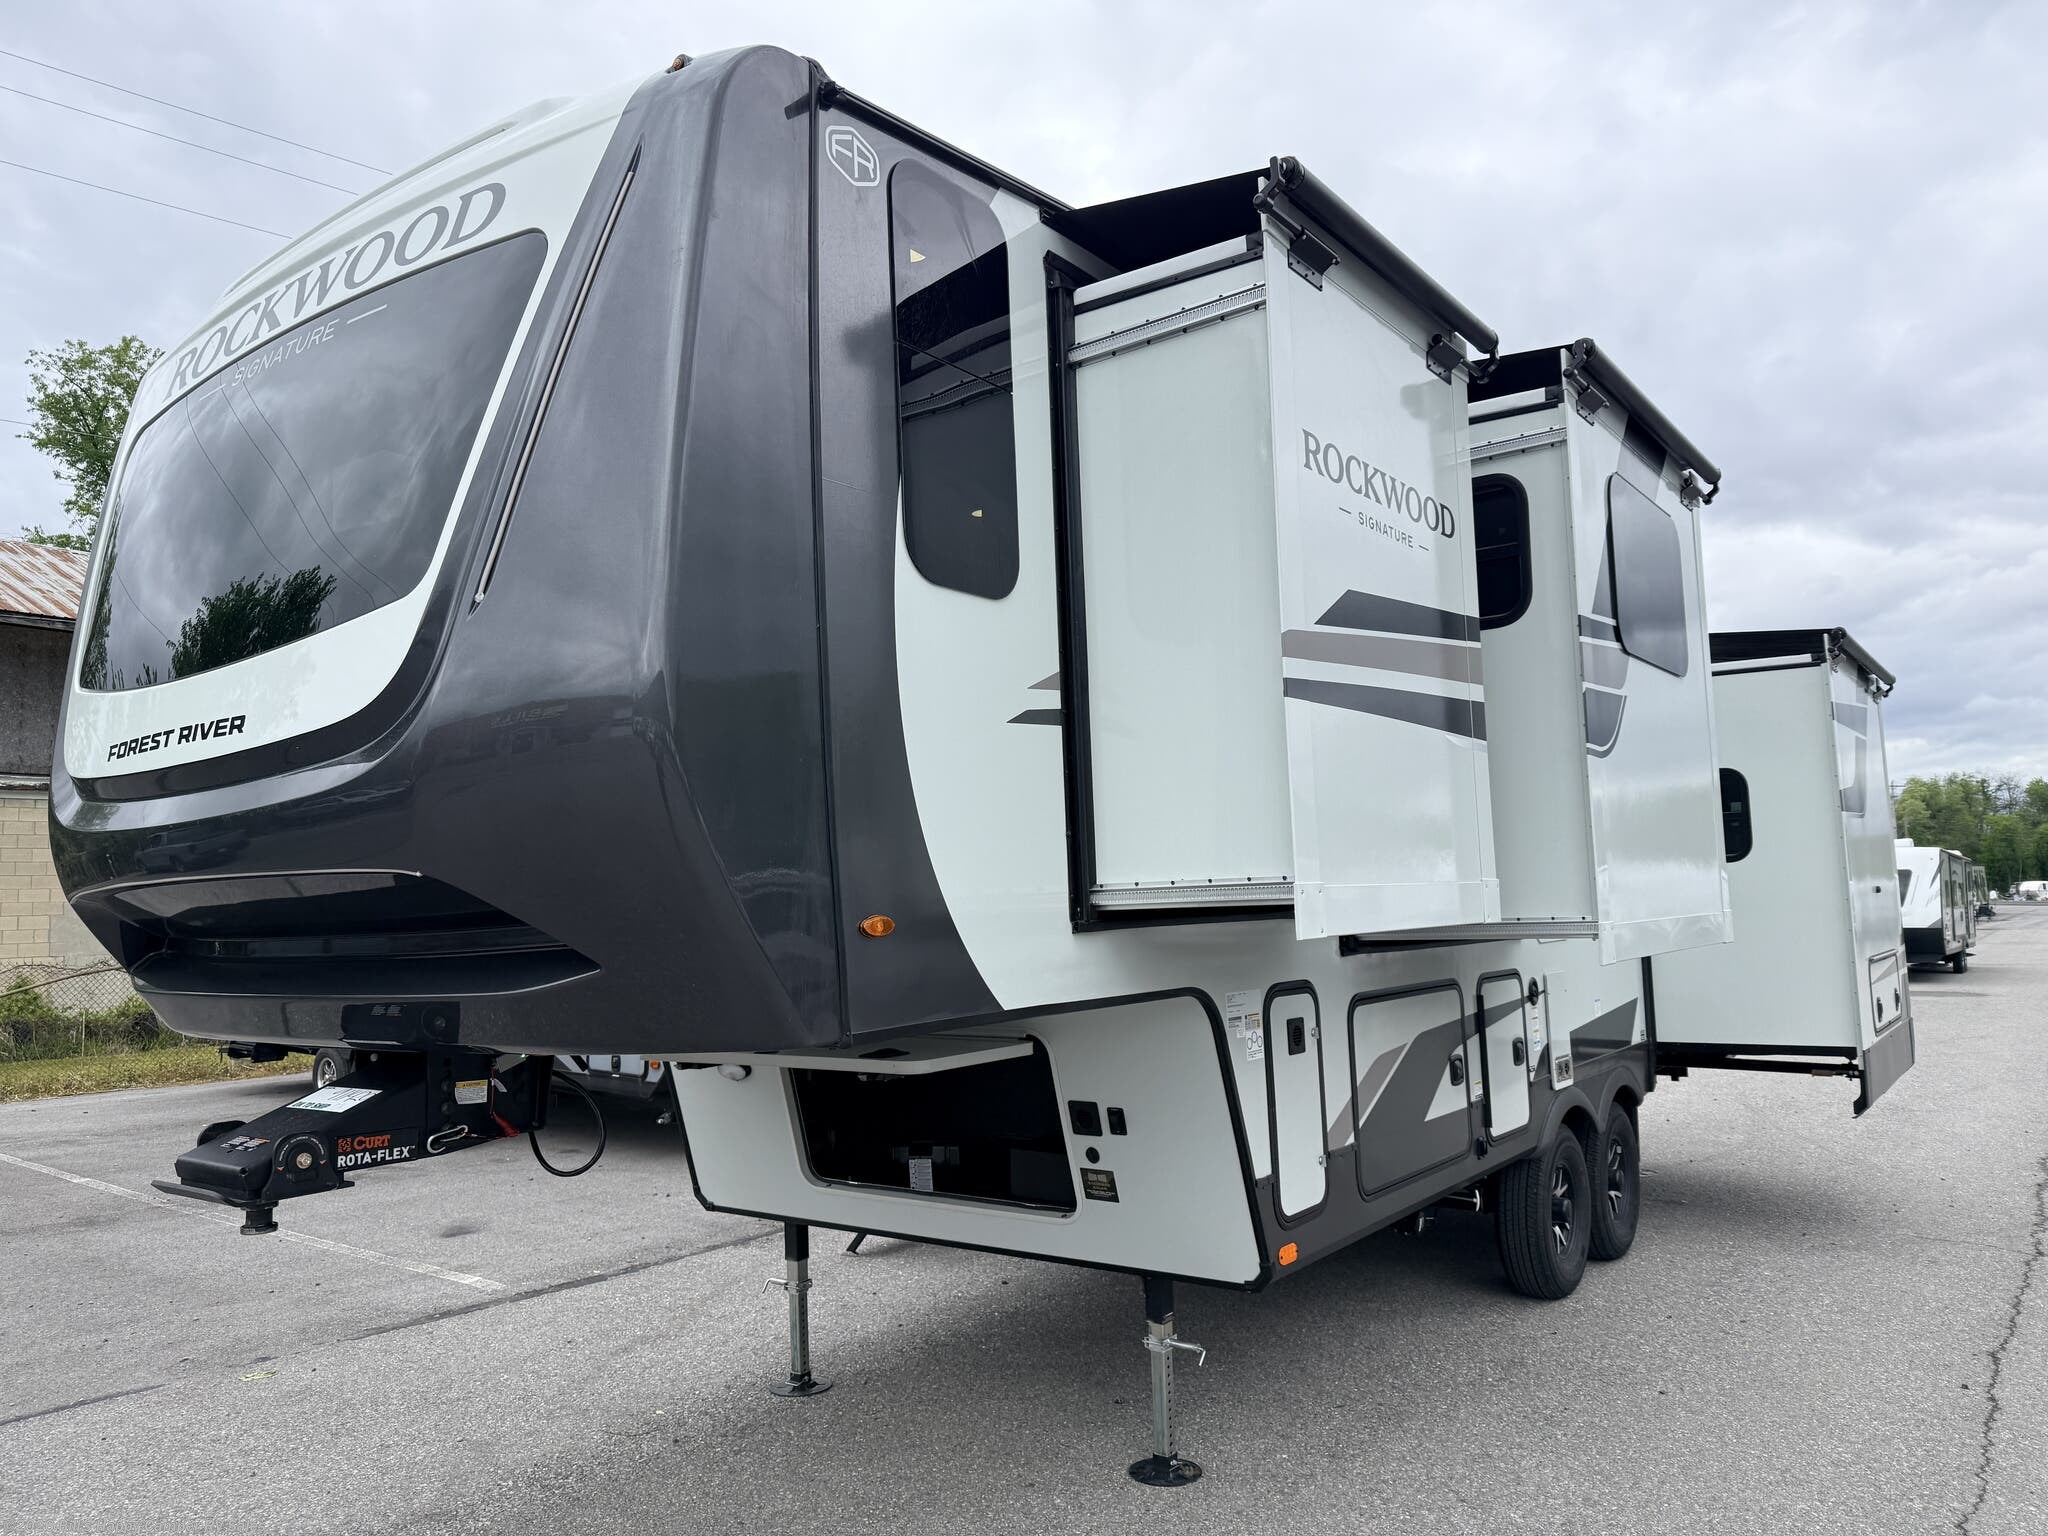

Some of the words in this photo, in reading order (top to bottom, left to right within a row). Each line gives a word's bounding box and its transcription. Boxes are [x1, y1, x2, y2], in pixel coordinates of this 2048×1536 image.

[162, 182, 506, 401] ROCKWOOD
[232, 319, 339, 387] SIGNATURE
[1302, 428, 1455, 539] ROCKWOOD
[1358, 512, 1414, 549] SIGNATURE
[107, 729, 175, 762] FOREST
[177, 714, 246, 745] RIVER
[353, 1135, 391, 1150] CURT
